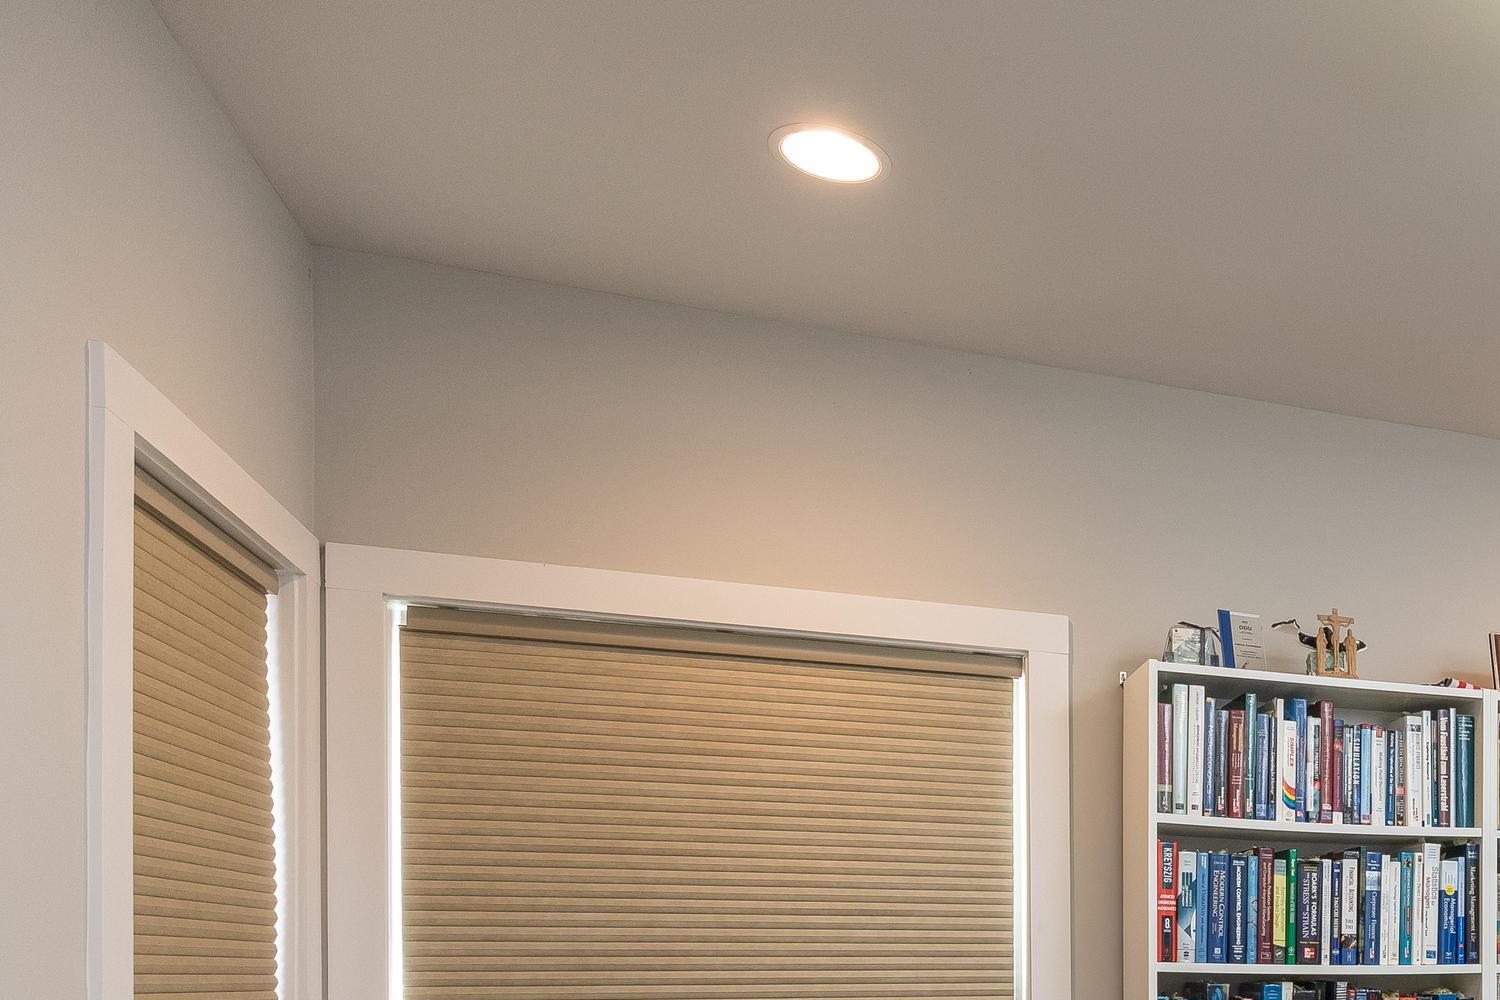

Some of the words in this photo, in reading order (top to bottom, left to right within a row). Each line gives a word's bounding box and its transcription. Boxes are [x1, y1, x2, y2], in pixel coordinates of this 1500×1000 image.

[1440, 731, 1448, 760] Faustkeil
[1440, 761, 1448, 774] zum
[1163, 848, 1172, 883] KREYSZIG
[1165, 918, 1171, 929] 8
